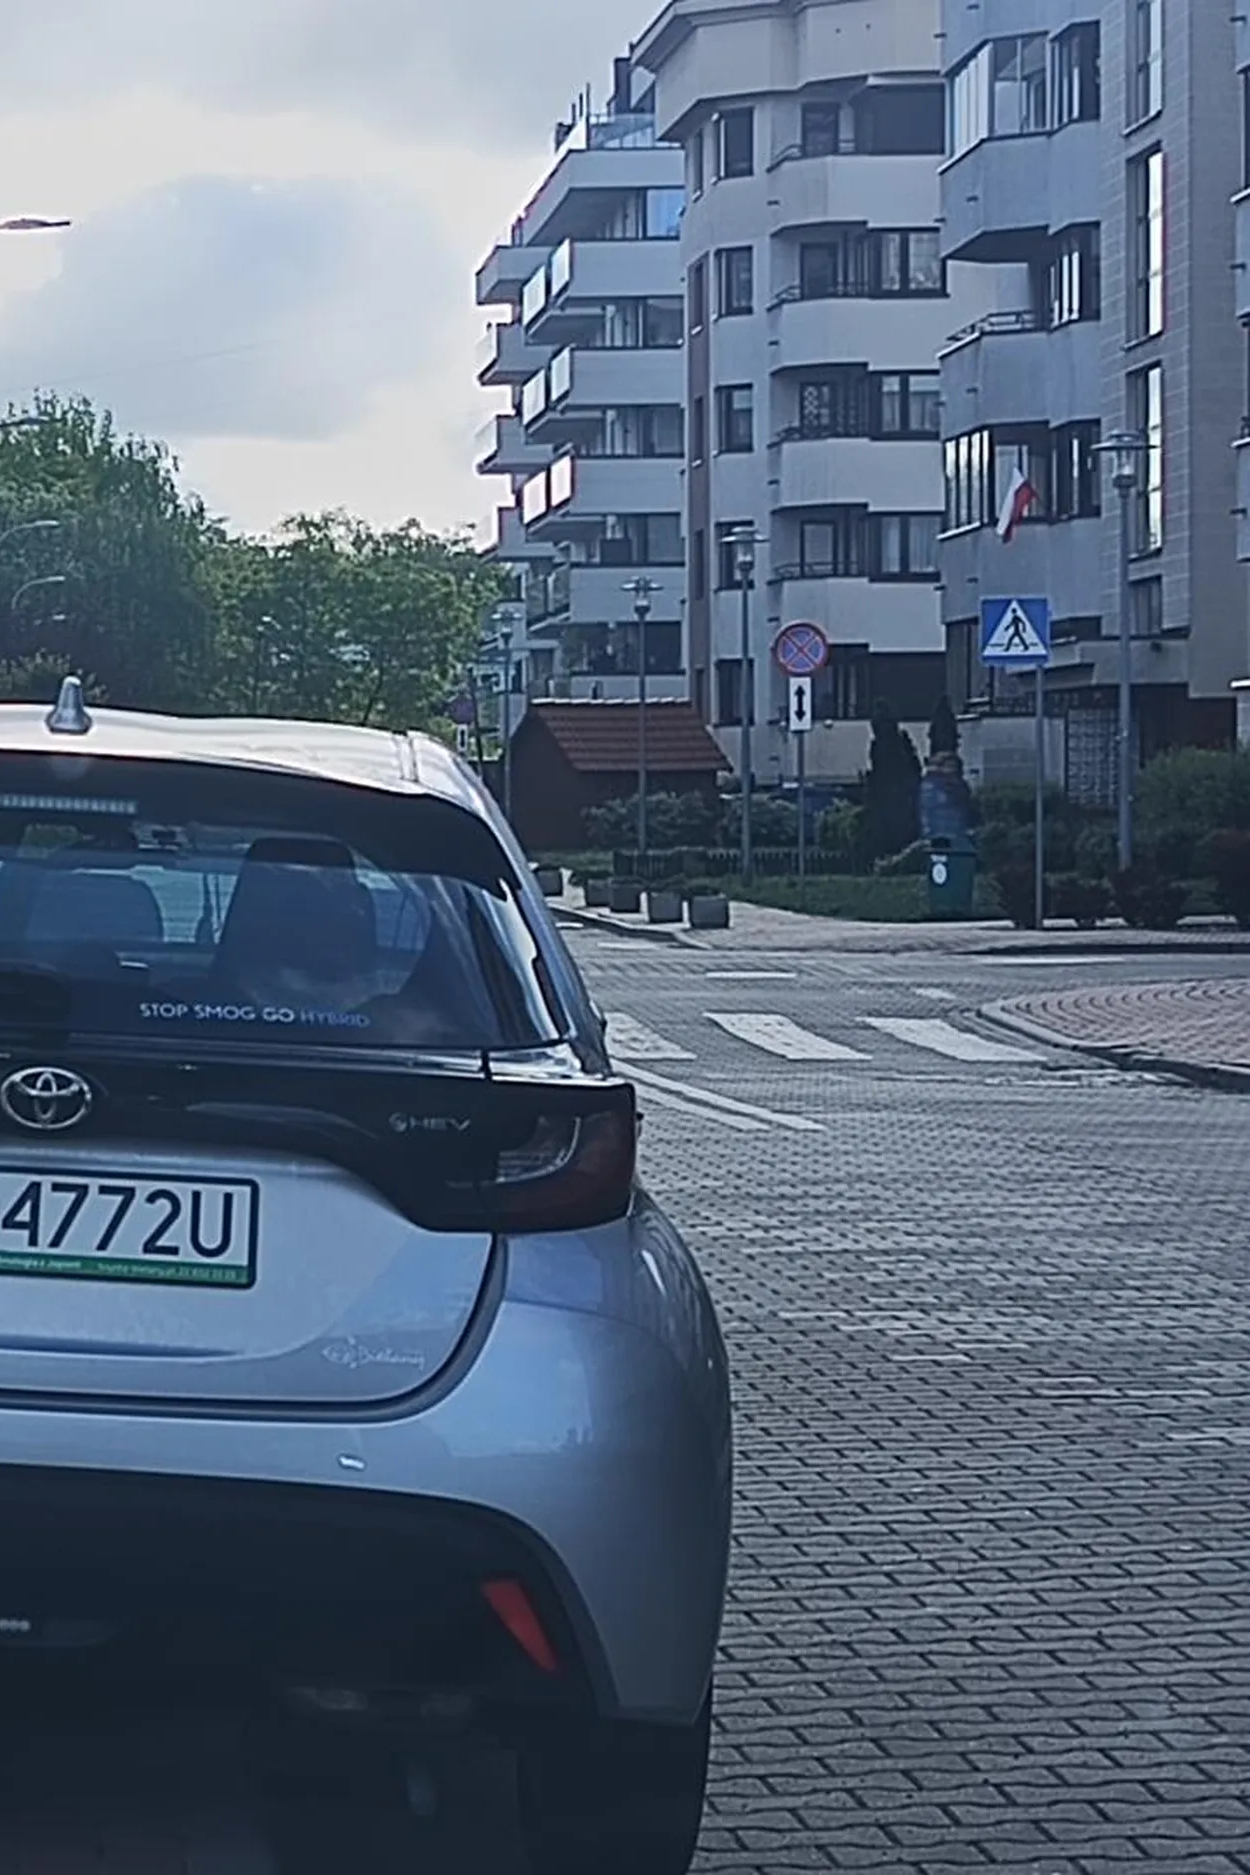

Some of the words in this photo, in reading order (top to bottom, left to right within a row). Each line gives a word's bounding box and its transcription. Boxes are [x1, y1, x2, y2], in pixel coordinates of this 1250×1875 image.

[139, 1003, 188, 1018] STOP
[194, 1004, 256, 1021] SMOG
[262, 1006, 295, 1023] GO
[300, 1008, 371, 1029] HYBRID
[0, 1180, 235, 1259] 4772U
